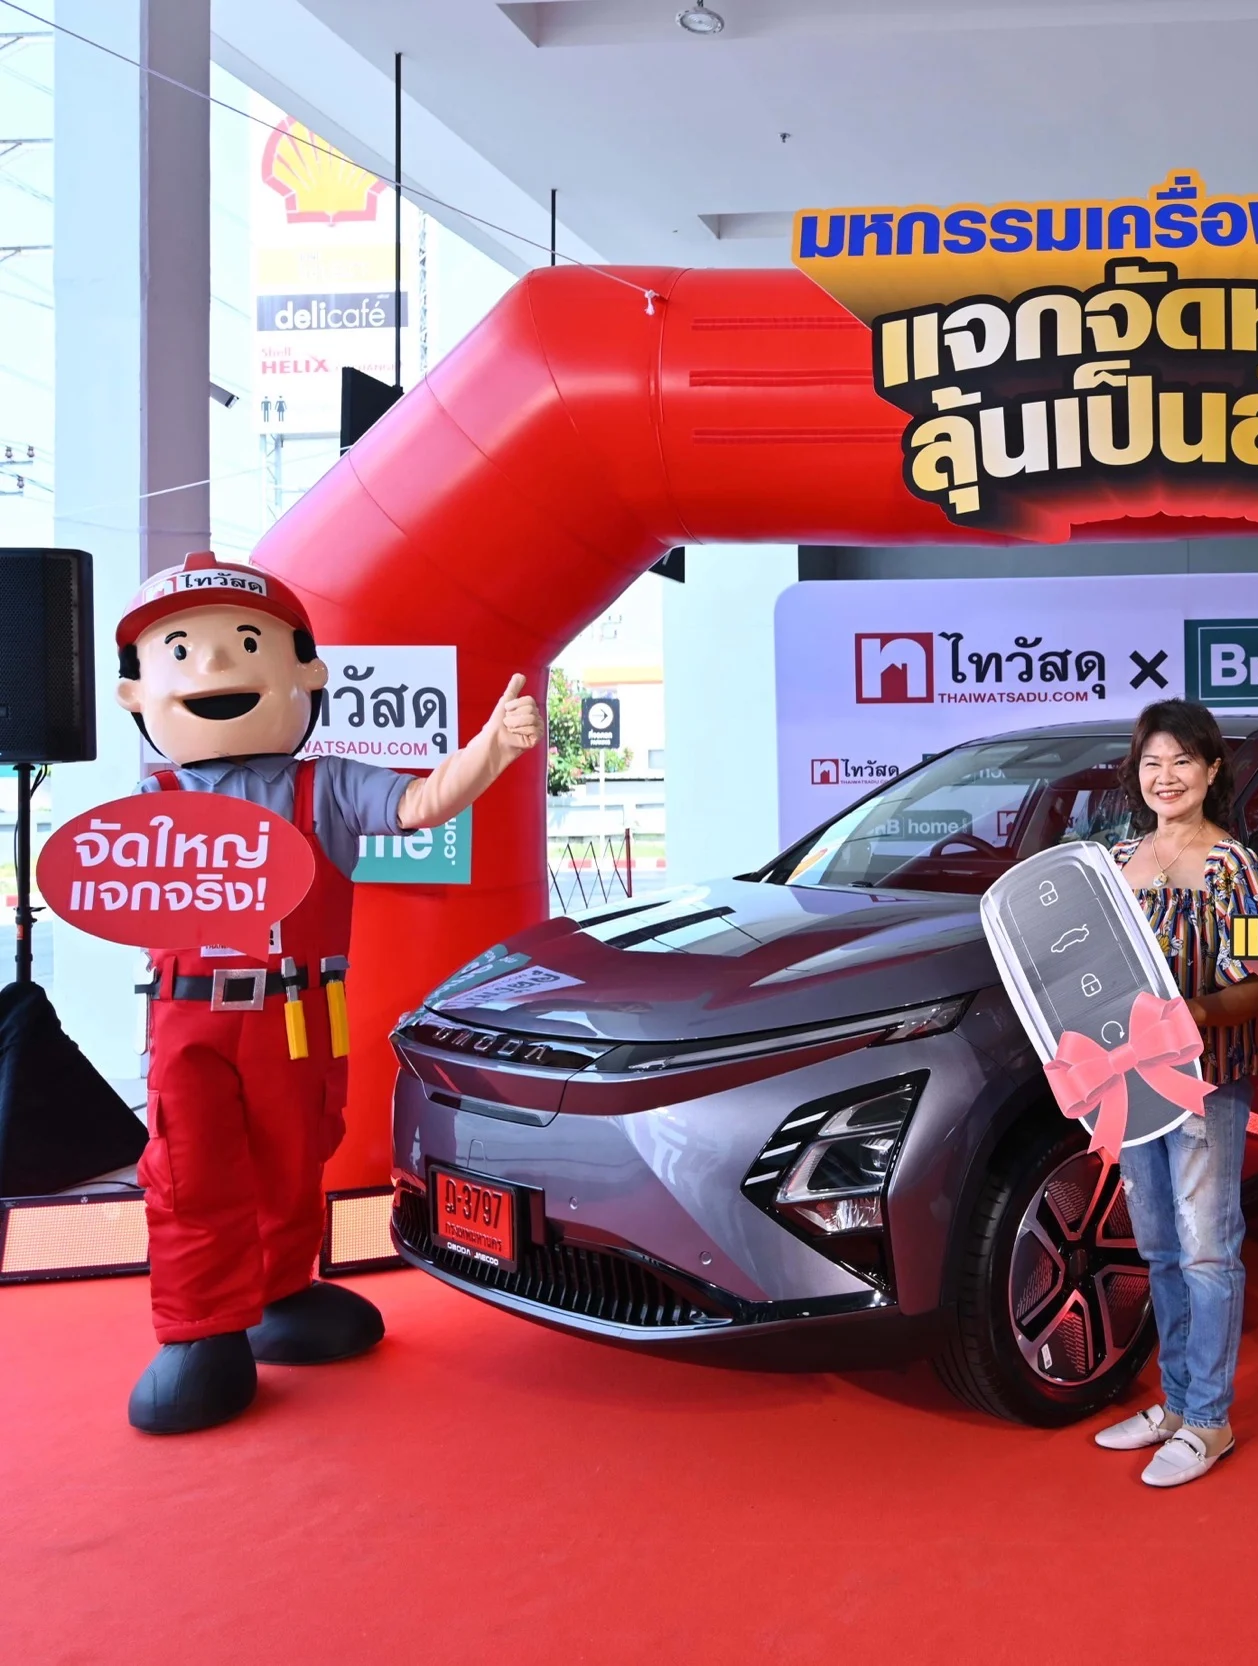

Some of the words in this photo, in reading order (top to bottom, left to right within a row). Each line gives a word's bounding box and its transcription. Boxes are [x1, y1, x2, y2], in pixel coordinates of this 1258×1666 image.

[274, 298, 386, 330] delicafé
[261, 353, 329, 374] HELIX
[180, 572, 264, 594] ไทวัสด
[938, 631, 1106, 700] ไทวัสดุ
[938, 691, 1089, 704] THAIWATSADU.COM
[322, 664, 448, 754] วัสดุ
[302, 740, 428, 756] WATSADU.COM
[840, 758, 900, 778] ไทวัสด
[908, 819, 959, 834] home
[73, 815, 270, 869] จัดใหญ่
[69, 874, 268, 912] แจกจริง!
